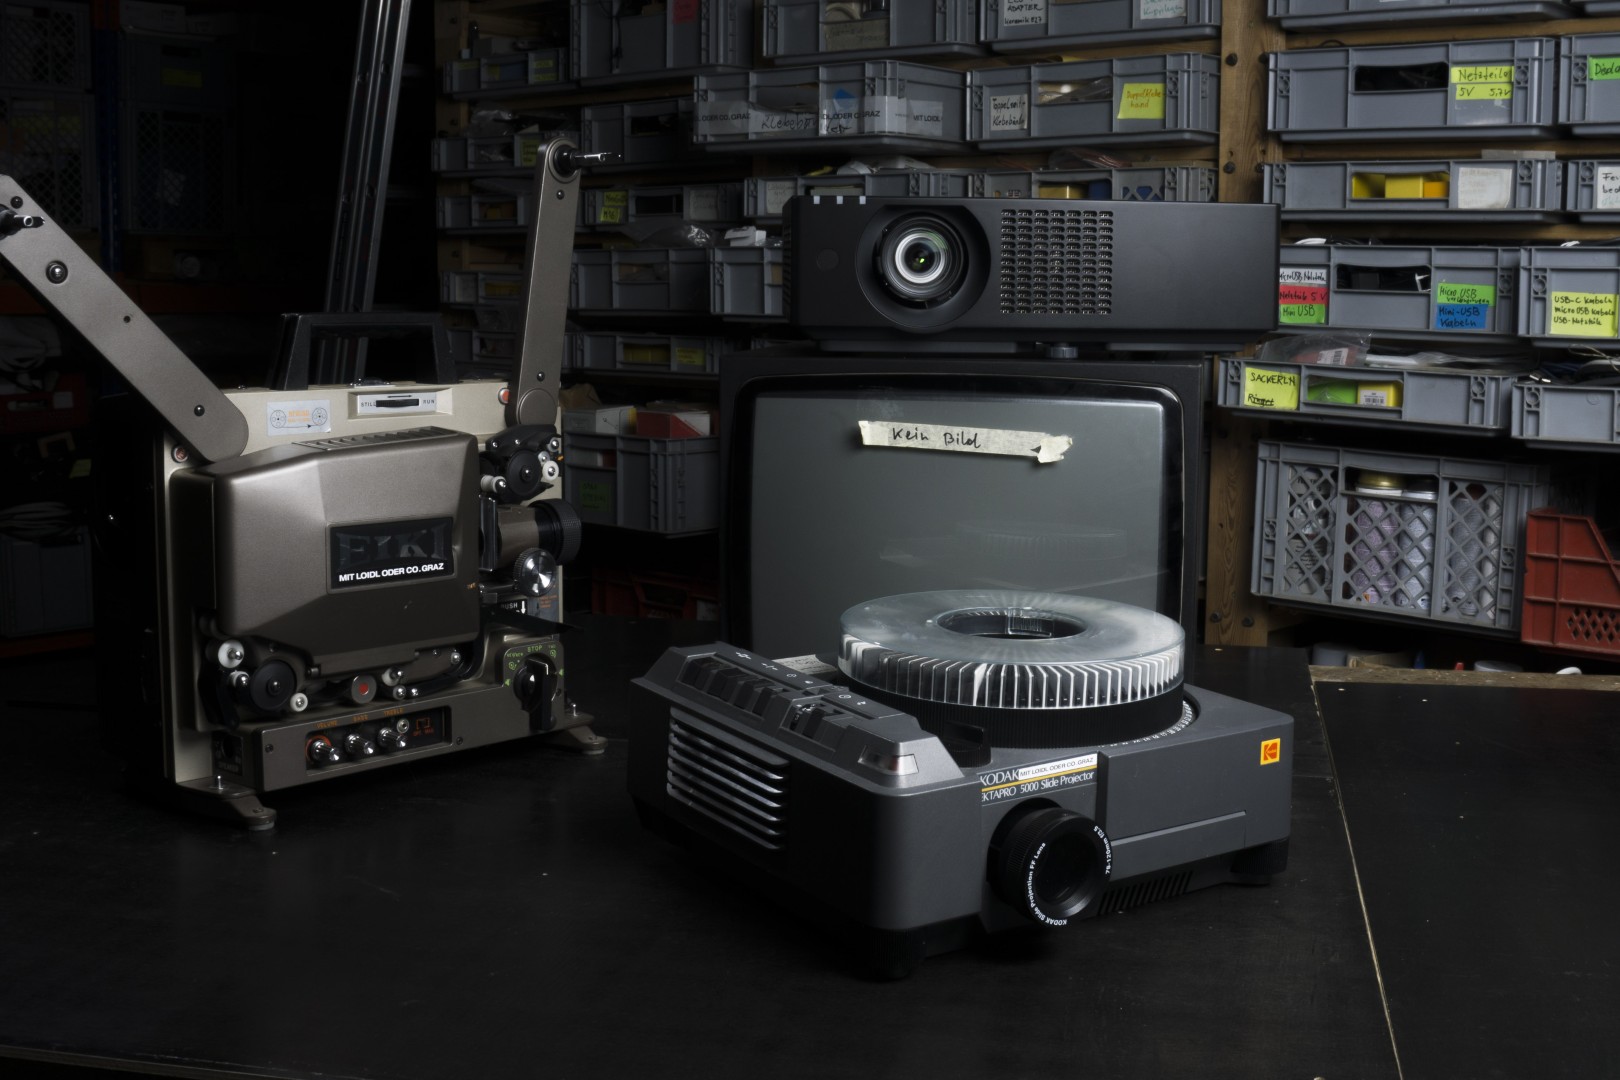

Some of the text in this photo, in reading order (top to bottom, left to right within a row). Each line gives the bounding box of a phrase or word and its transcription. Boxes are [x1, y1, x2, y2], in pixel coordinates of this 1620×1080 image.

[1459, 86, 1476, 97] 5V
[1459, 289, 1478, 299] USB
[1297, 304, 1316, 317] USB
[892, 427, 981, 449] Kein Bild
[338, 573, 354, 582] MIT
[355, 570, 381, 580] LOIDL
[381, 567, 405, 577] ODER
[527, 644, 543, 653] STOP
[1020, 782, 1039, 794] 5000
[1040, 777, 1059, 790] Slide
[1059, 771, 1095, 785] Projector
[1033, 842, 1046, 859] Lens
[1026, 870, 1036, 909] Projection
[1034, 906, 1046, 921] Slide
[1045, 916, 1068, 926] KODAK
